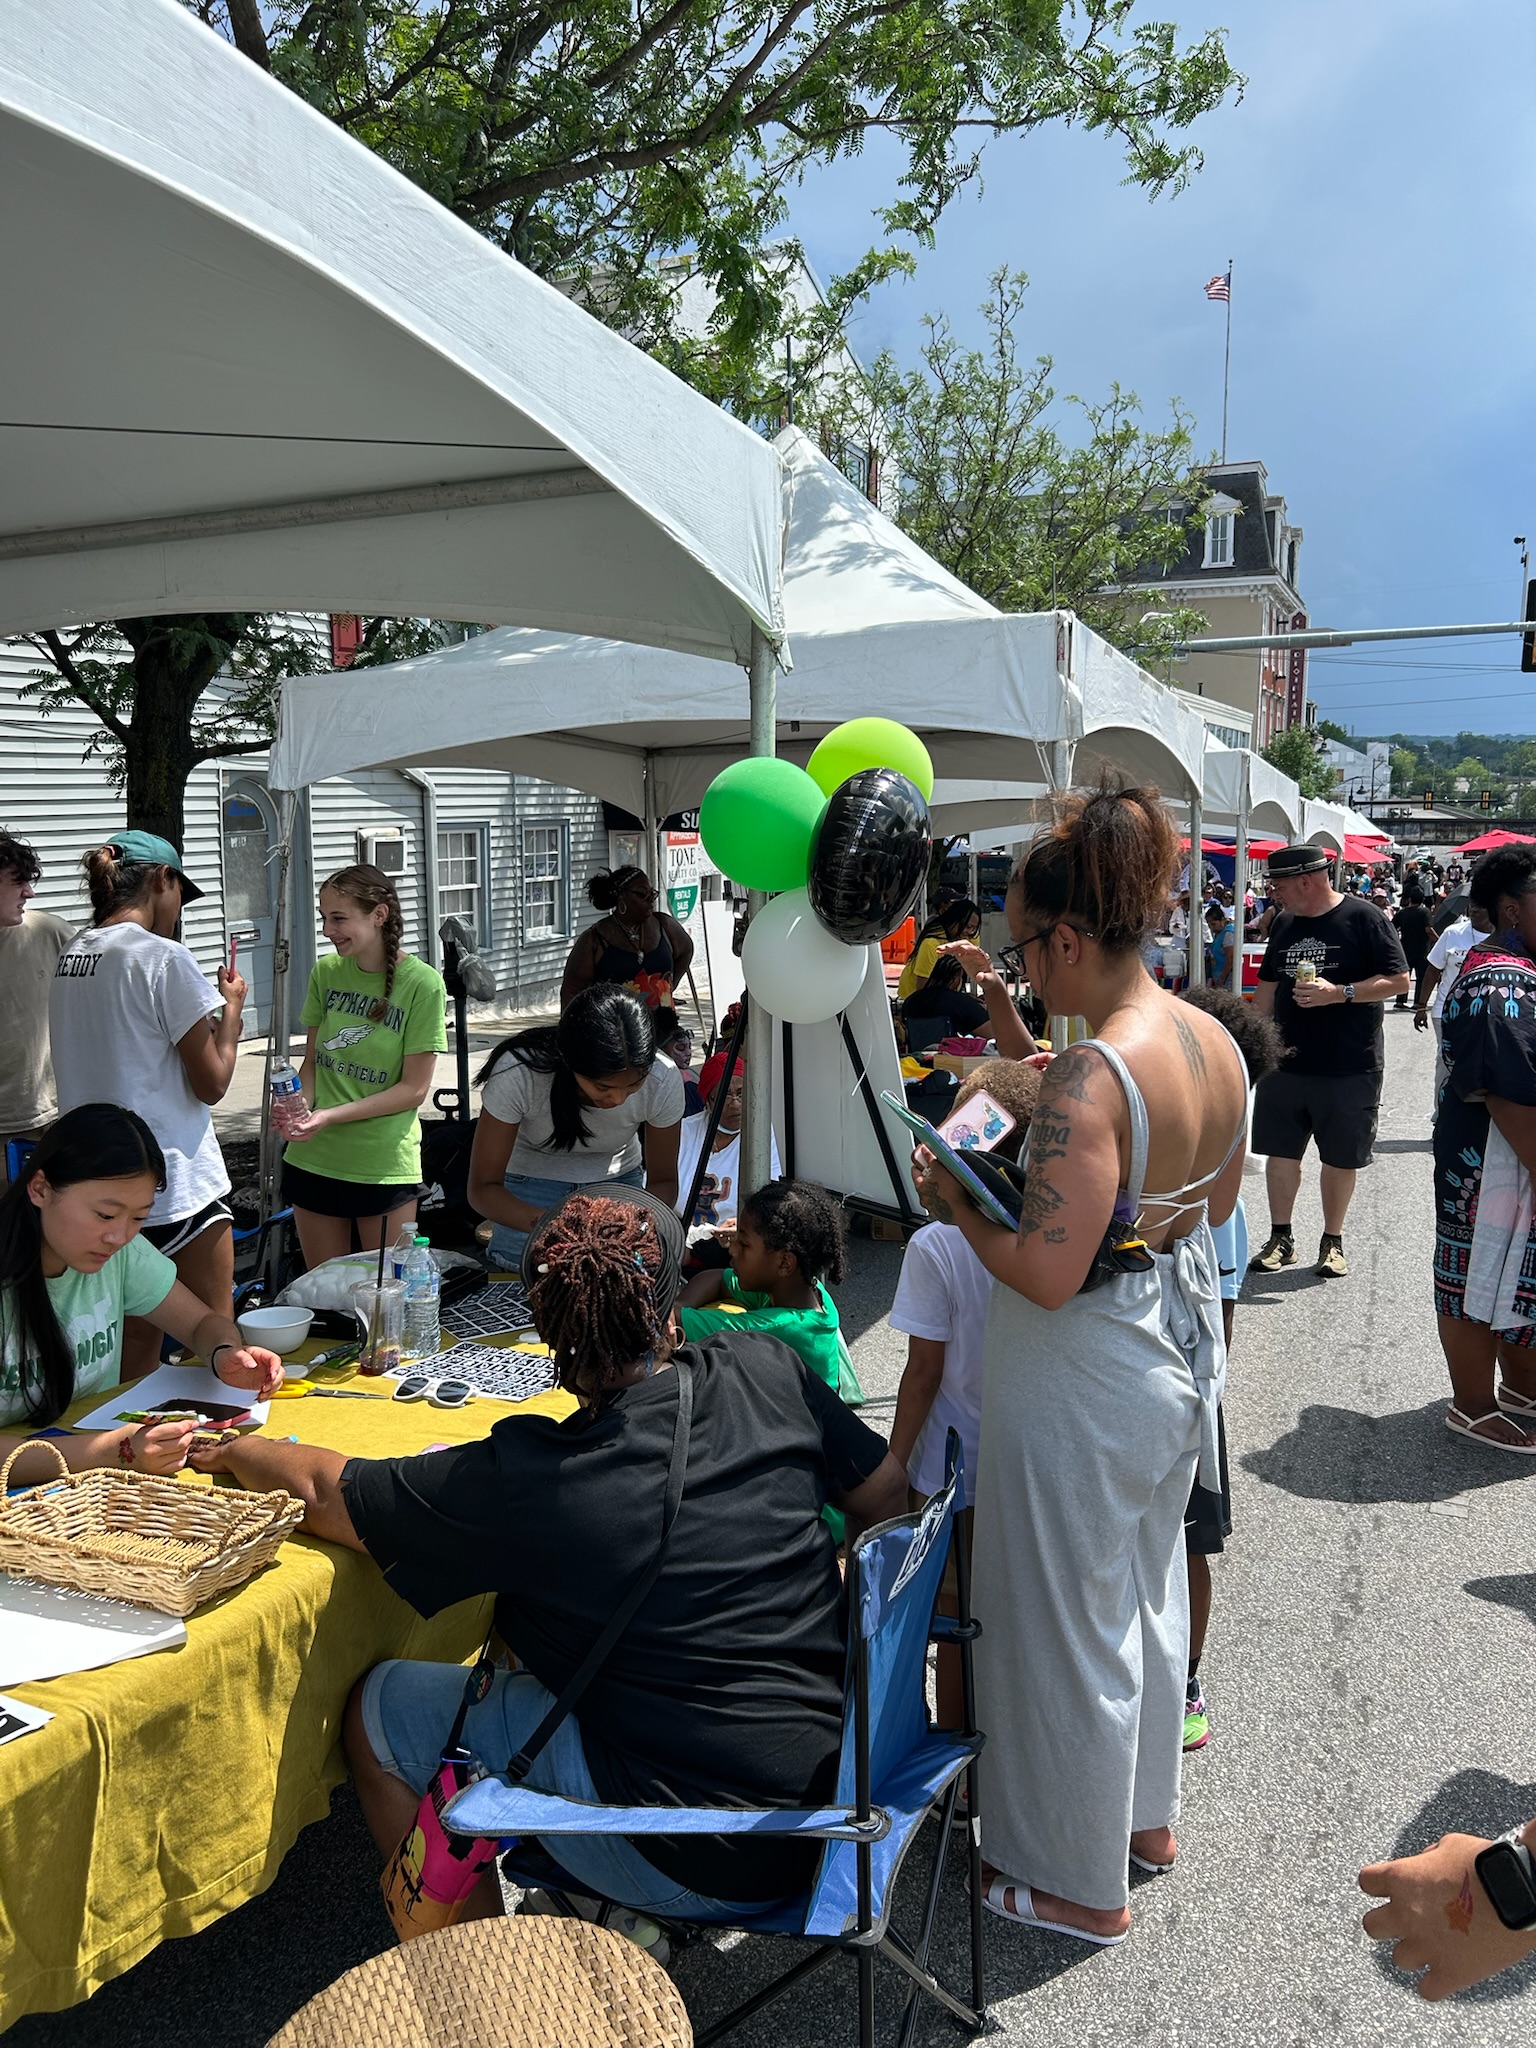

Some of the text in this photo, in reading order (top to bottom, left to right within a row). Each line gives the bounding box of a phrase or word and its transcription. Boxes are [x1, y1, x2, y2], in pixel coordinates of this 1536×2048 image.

[670, 847, 695, 867] TONE
[54, 953, 103, 978] REDDY
[324, 988, 405, 1033] ETHACON
[337, 1061, 346, 1074] &
[347, 1062, 389, 1085] FIELD
